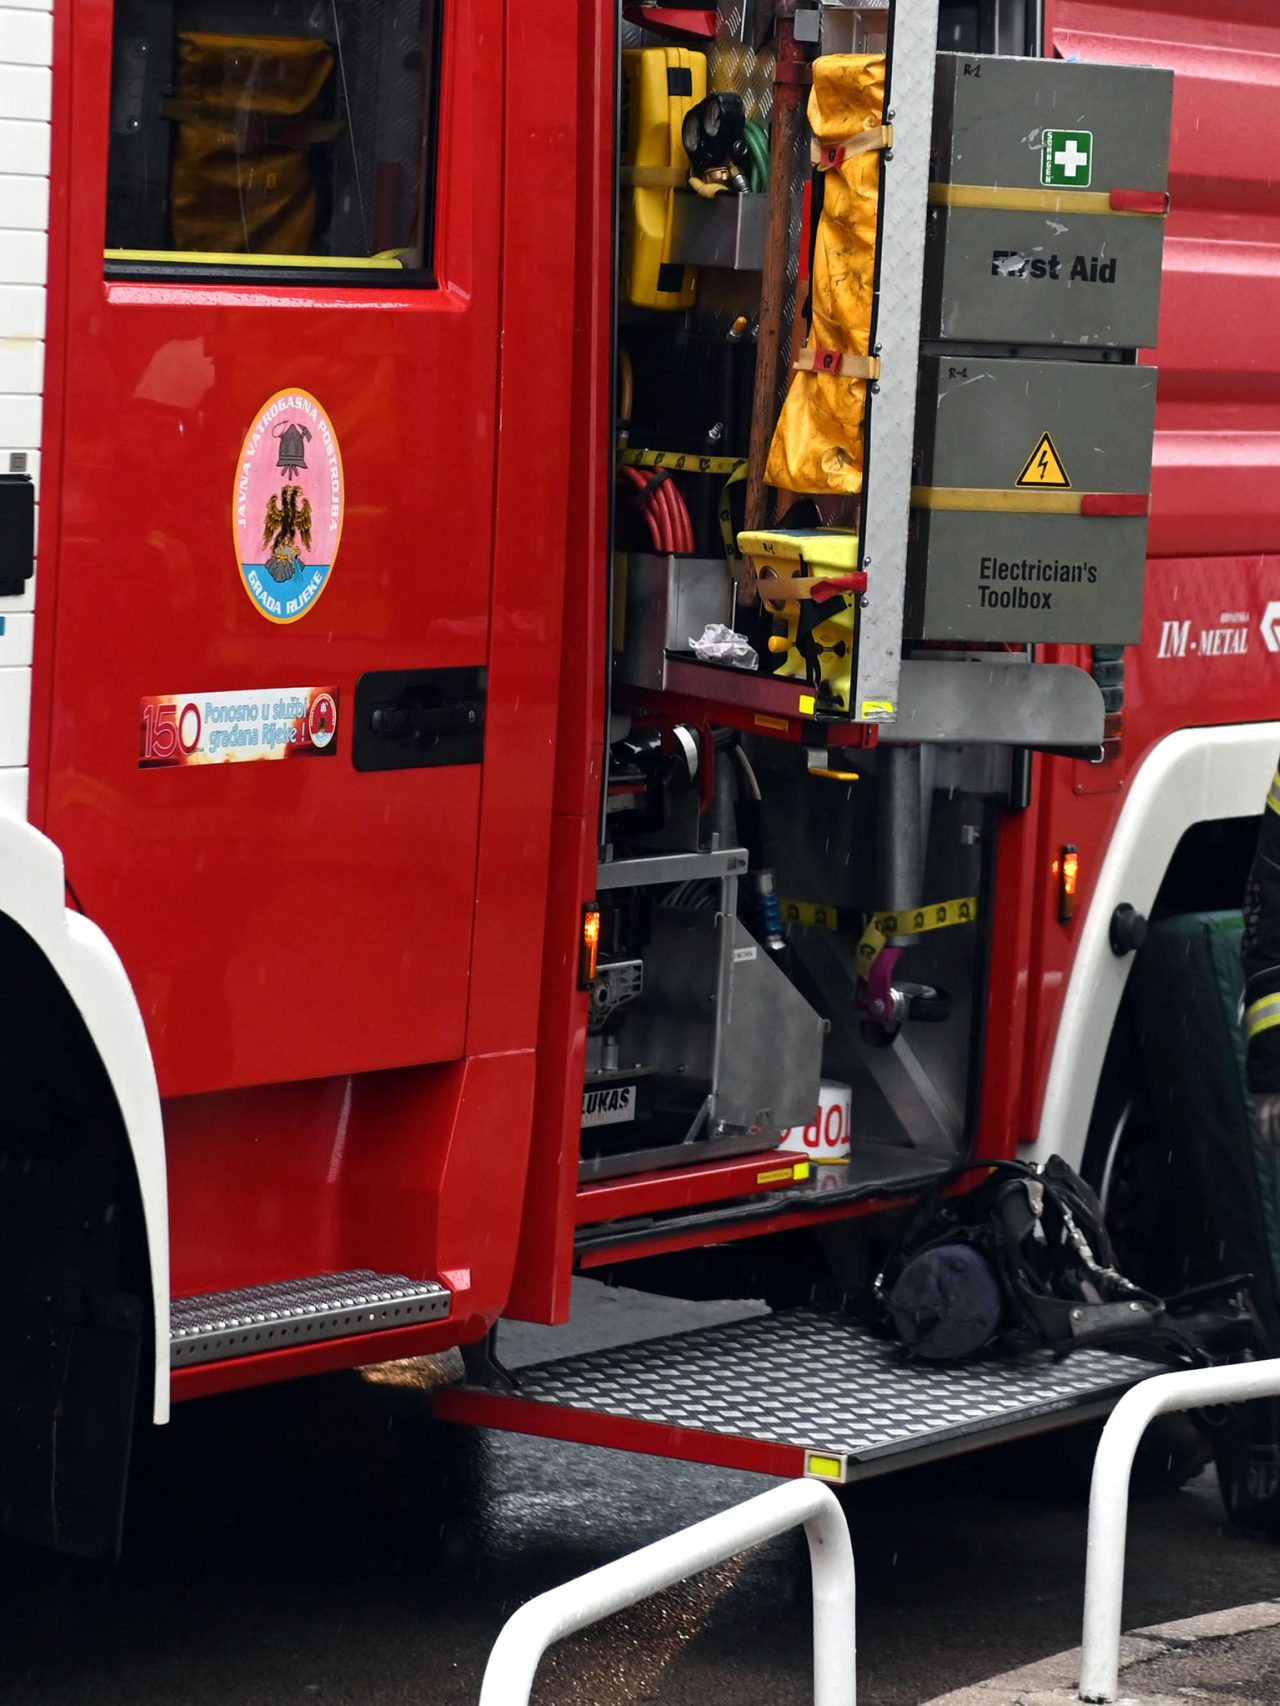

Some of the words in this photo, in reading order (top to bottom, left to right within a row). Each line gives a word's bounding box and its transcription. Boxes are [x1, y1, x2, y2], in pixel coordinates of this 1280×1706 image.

[1070, 255, 1116, 283] Aid
[237, 462, 252, 529] JAVNA
[247, 396, 318, 457] VATROGASNA
[317, 421, 340, 531] POSTROJBA
[979, 557, 1097, 583] Electrician's
[248, 570, 282, 615] GRADA
[978, 585, 1052, 609] Toolbox
[204, 702, 258, 724] Ponosno
[262, 704, 272, 720] u
[143, 702, 202, 758] 150
[582, 1088, 630, 1115] UKAS
